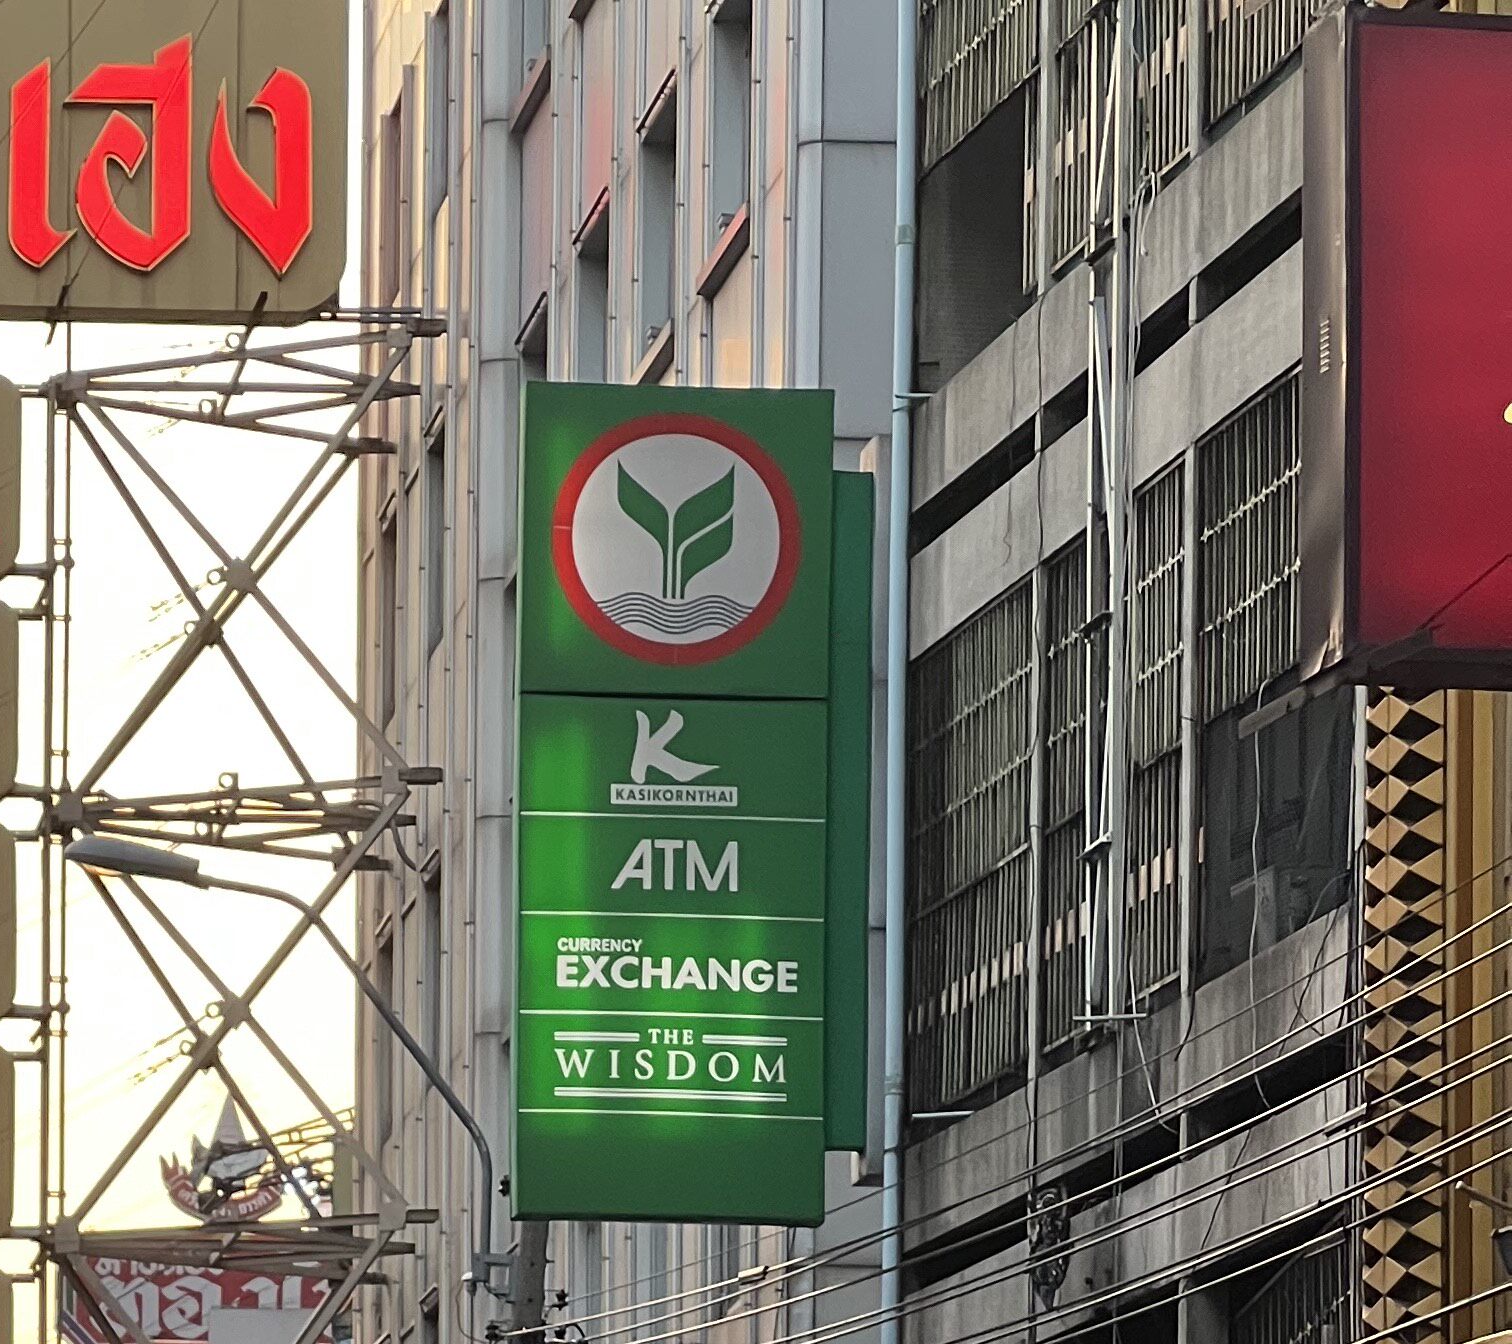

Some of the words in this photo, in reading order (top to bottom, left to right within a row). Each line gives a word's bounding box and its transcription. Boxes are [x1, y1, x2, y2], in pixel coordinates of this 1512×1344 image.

[630, 708, 720, 783] K
[615, 787, 735, 804] KASIKORNTHAI
[610, 838, 740, 894] ATM
[556, 936, 644, 953] CURRENCY
[555, 955, 800, 993] EXCHANGE
[647, 1027, 695, 1046] THE
[555, 1049, 788, 1085] WISDOM
